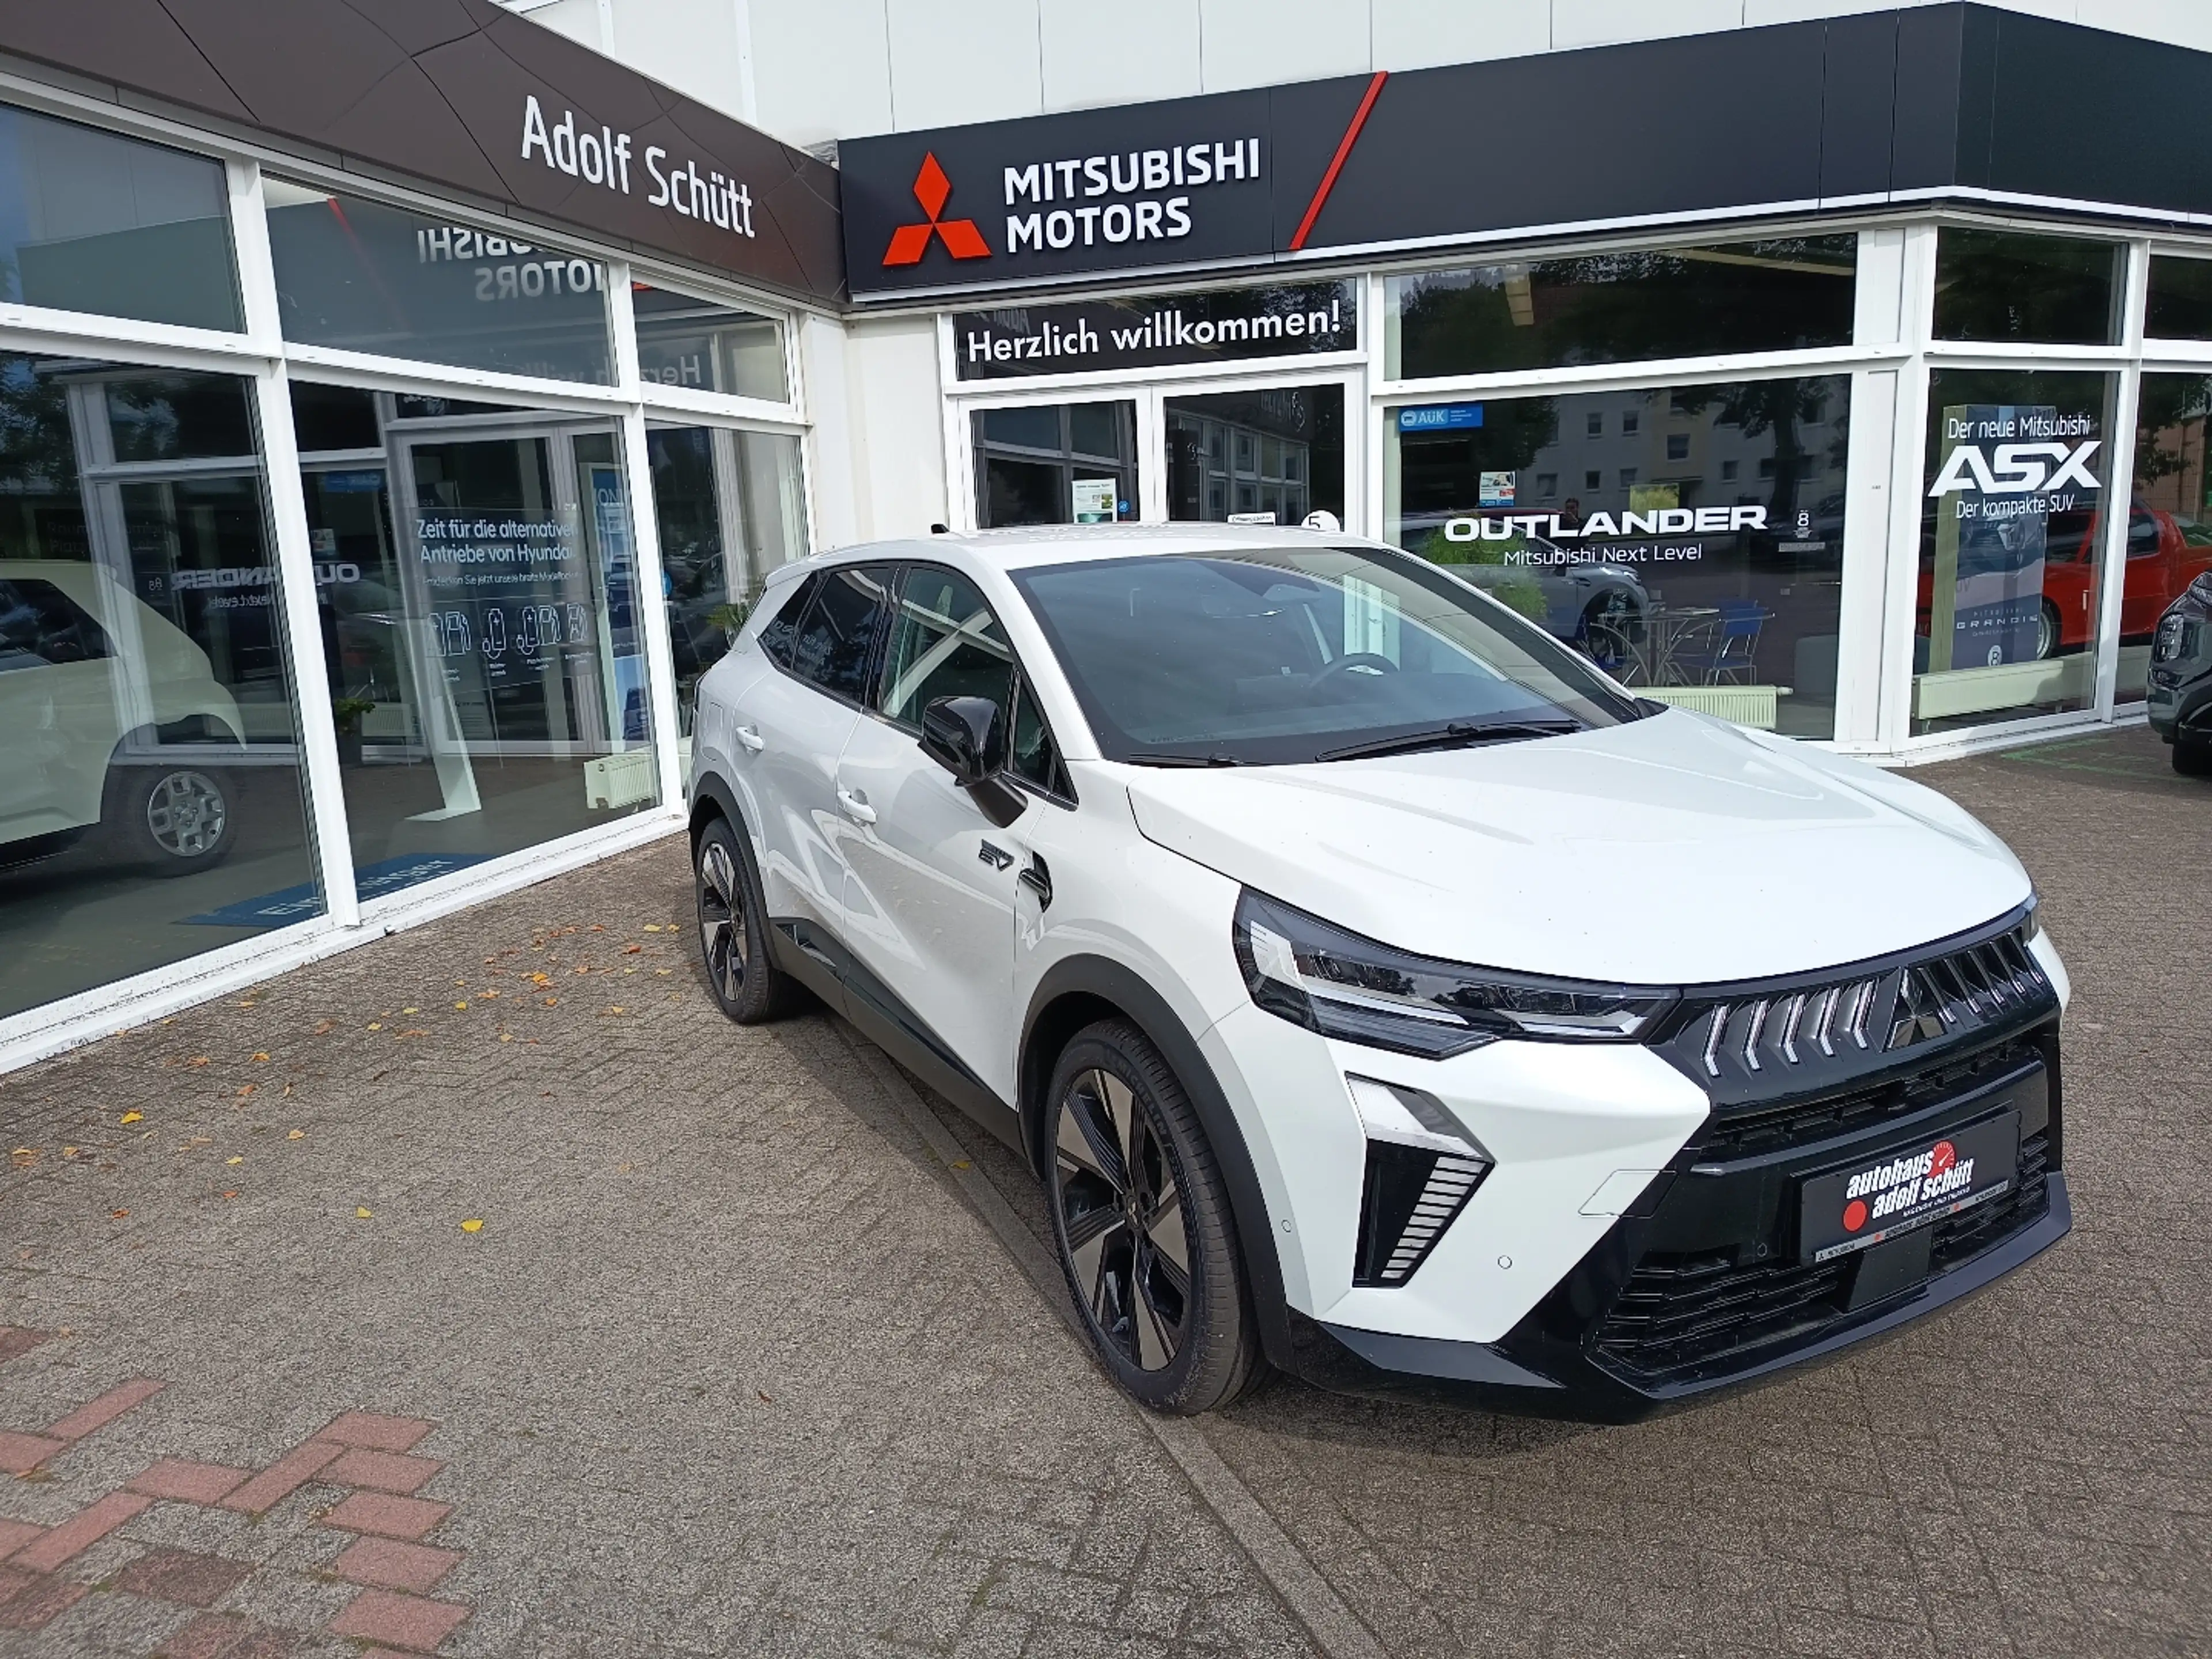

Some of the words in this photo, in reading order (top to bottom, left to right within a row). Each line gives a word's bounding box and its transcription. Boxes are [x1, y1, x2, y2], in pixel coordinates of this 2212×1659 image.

[521, 94, 632, 195] Adolf
[645, 146, 755, 237] Schütt
[1004, 138, 1260, 206] MITSUBISHI
[1006, 196, 1192, 254] MOTORS
[968, 317, 1099, 362] Herzlich
[1111, 300, 1341, 350] willkommen!
[1948, 418, 1974, 439] Der
[1978, 419, 2015, 438] neue
[2020, 415, 2090, 437] Mitsubishi
[1927, 441, 2103, 497] ASX
[1445, 505, 1768, 541] OUTLANDER
[1956, 500, 1979, 519] Der
[1983, 495, 2046, 518] kompakte
[2049, 494, 2075, 513] SUV
[416, 518, 446, 539] Zeit
[449, 518, 471, 539] für
[474, 518, 497, 538] die
[421, 544, 485, 564] Antriebe
[487, 547, 515, 562] von
[1503, 545, 1596, 566] Mitsubishi
[1603, 547, 1648, 563] Next
[1653, 543, 1703, 561] Level
[1956, 614, 2038, 630] GRANDIS
[1846, 1150, 1934, 1199] autohaus
[1873, 1177, 1922, 1219] adolf
[1921, 1158, 1974, 1201] schütt
